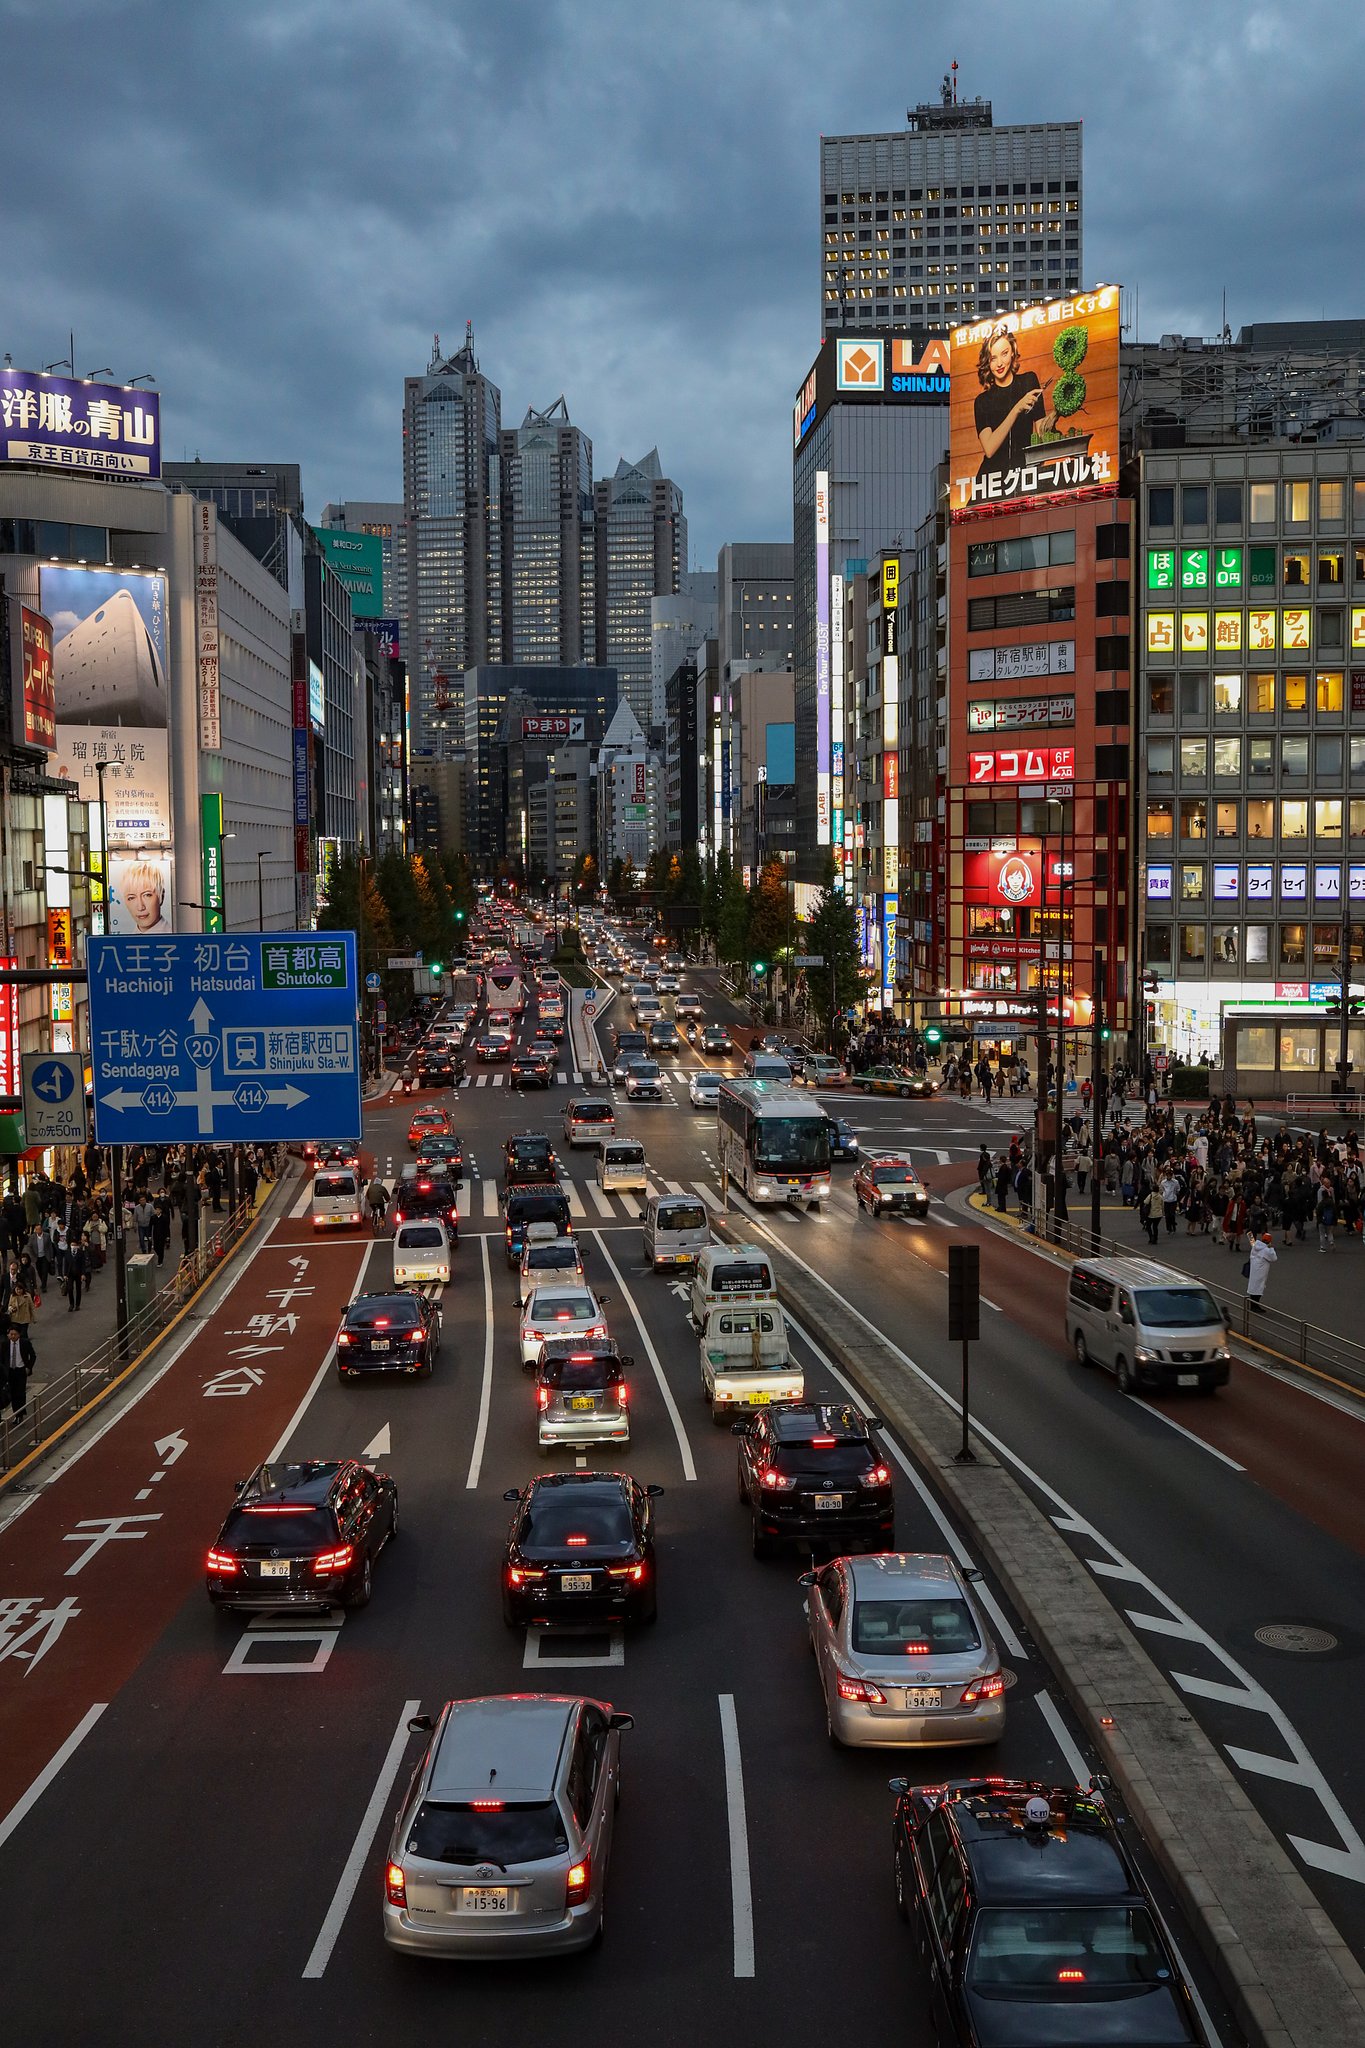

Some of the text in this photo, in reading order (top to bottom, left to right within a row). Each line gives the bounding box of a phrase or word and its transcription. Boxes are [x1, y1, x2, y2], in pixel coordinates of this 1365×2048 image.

[2, 388, 155, 445] 洋服の青山
[27, 444, 134, 469] 京王百貨店向い
[955, 450, 1111, 503] THEグローバル社
[1153, 551, 1236, 569] ほぐし
[198, 565, 216, 575] 共立
[1157, 571, 1240, 587] 2,980円
[344, 580, 373, 594] MIWA
[1150, 619, 1239, 645] 占い館
[997, 646, 1047, 664] 新宿駅前
[1058, 644, 1067, 670] 歯科
[25, 652, 55, 702] スーパー
[978, 663, 1049, 679] デンタルクリニック
[819, 680, 828, 695] For
[686, 674, 694, 741] ホウライビル
[997, 707, 1072, 723] エーアイアール
[101, 730, 116, 738] 新宿
[526, 719, 567, 732] やまや
[72, 741, 145, 761] 瑠璃光院
[1055, 751, 1070, 763] 6F
[974, 751, 1044, 779] アコム
[297, 773, 306, 797] TOTAL
[1049, 786, 1071, 795] アコム
[297, 798, 306, 820] CLUB
[53, 919, 67, 960] 大黒屋
[97, 943, 251, 973] 八王子 初台
[266, 946, 342, 971] 首都高
[105, 972, 333, 995] Hachioji Hatsudai Shutoko
[192, 1041, 213, 1058] 20
[268, 1031, 349, 1055] 新宿駅西口
[101, 1062, 180, 1080] Sendagaya
[269, 1056, 350, 1072] Shinjuku Sta.-W.
[147, 1089, 263, 1107] 414 414
[31, 1125, 81, 1137] この先50m
[568, 1582, 591, 1590] 95-32
[913, 1697, 940, 1706] 94-75
[474, 1898, 506, 1910] 15-96
